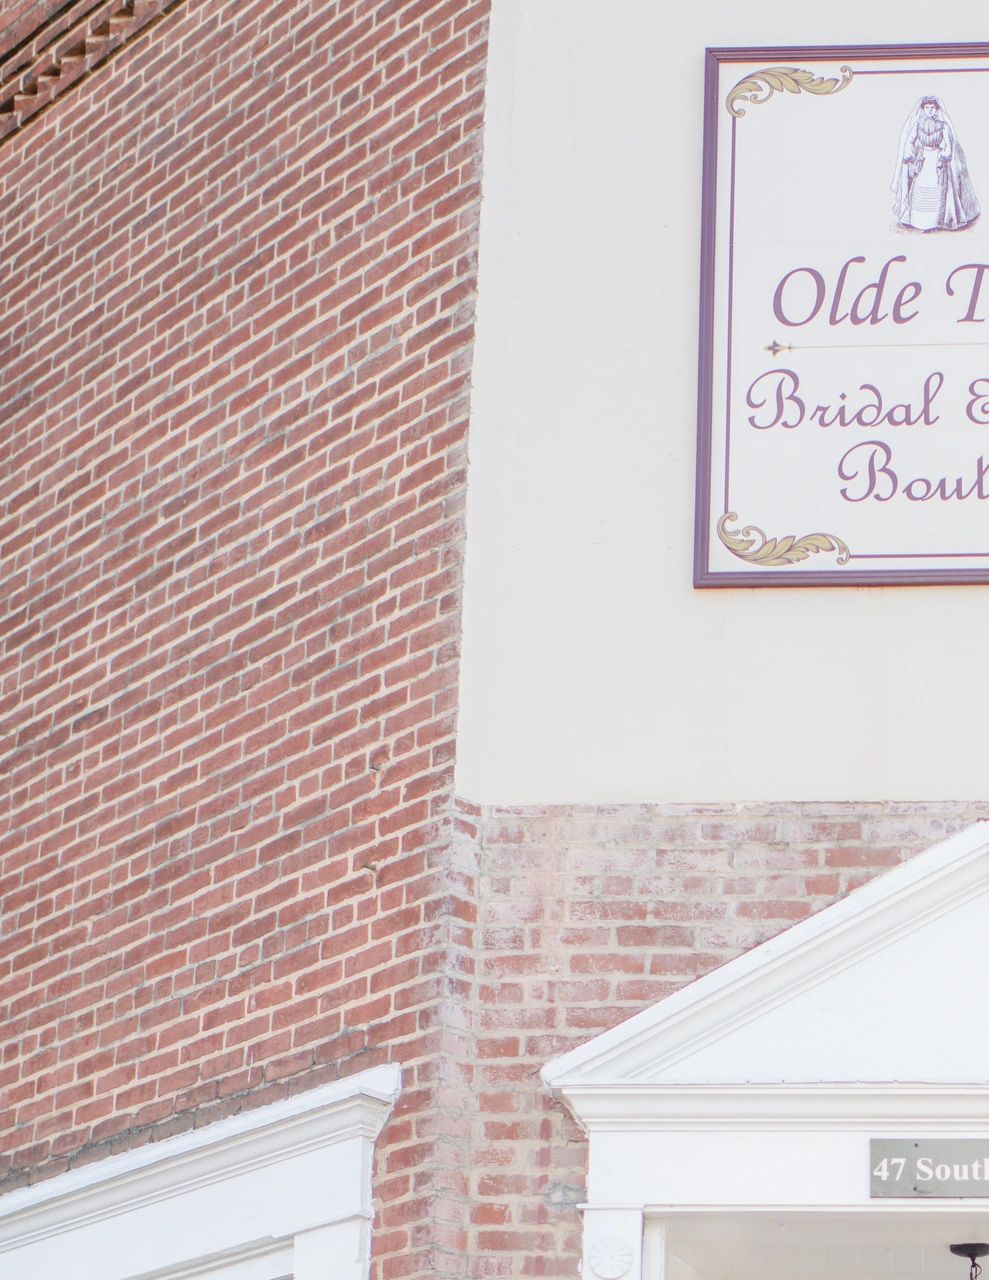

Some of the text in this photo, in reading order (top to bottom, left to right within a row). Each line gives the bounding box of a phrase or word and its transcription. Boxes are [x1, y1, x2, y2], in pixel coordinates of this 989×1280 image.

[773, 255, 922, 327] Olde
[746, 369, 945, 430] Bridal
[873, 1157, 907, 1181] 47
